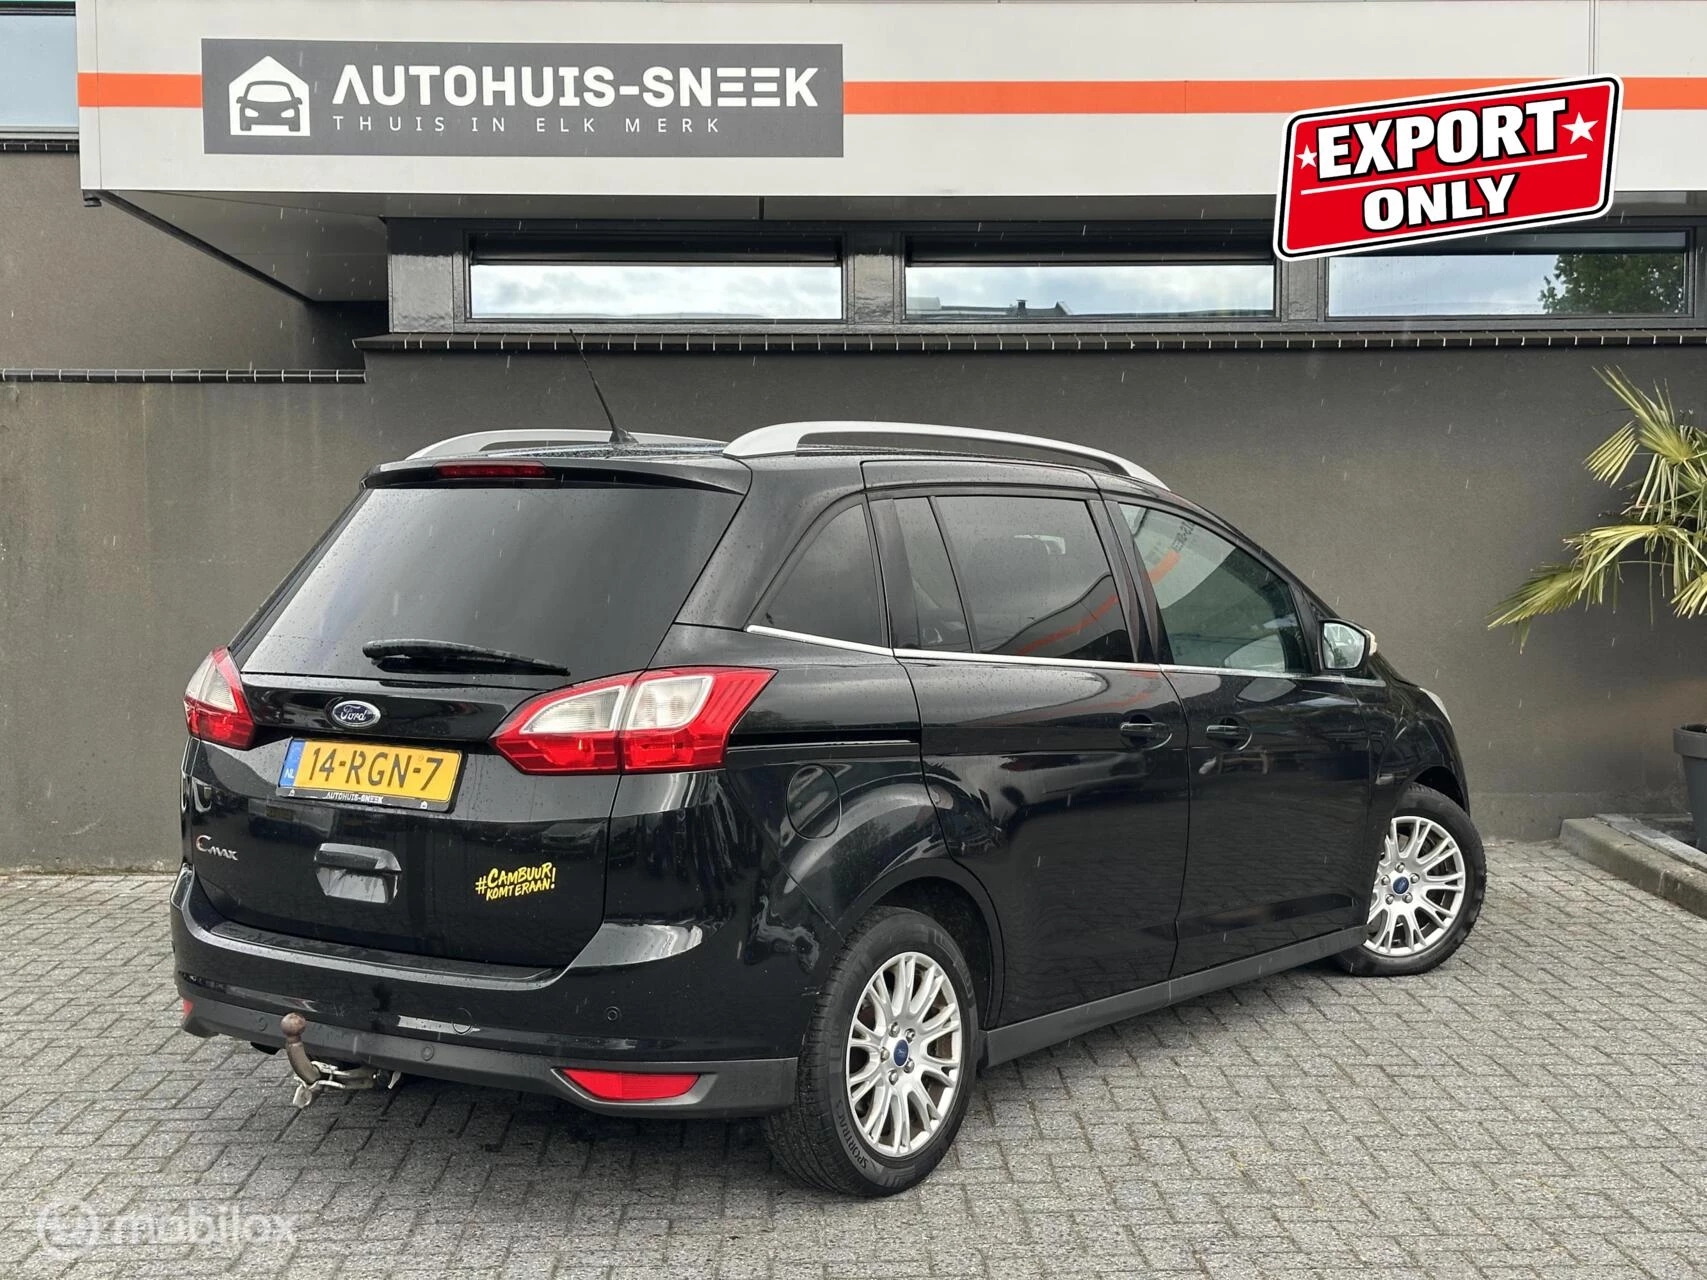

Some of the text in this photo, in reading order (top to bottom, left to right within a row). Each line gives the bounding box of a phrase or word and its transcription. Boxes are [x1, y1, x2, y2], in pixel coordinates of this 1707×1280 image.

[331, 64, 819, 108] AUTOHUIS-SNEEK
[332, 115, 719, 133] THUIS IN ELK MERK
[284, 767, 296, 779] NL
[308, 746, 444, 791] 14-RGN-7
